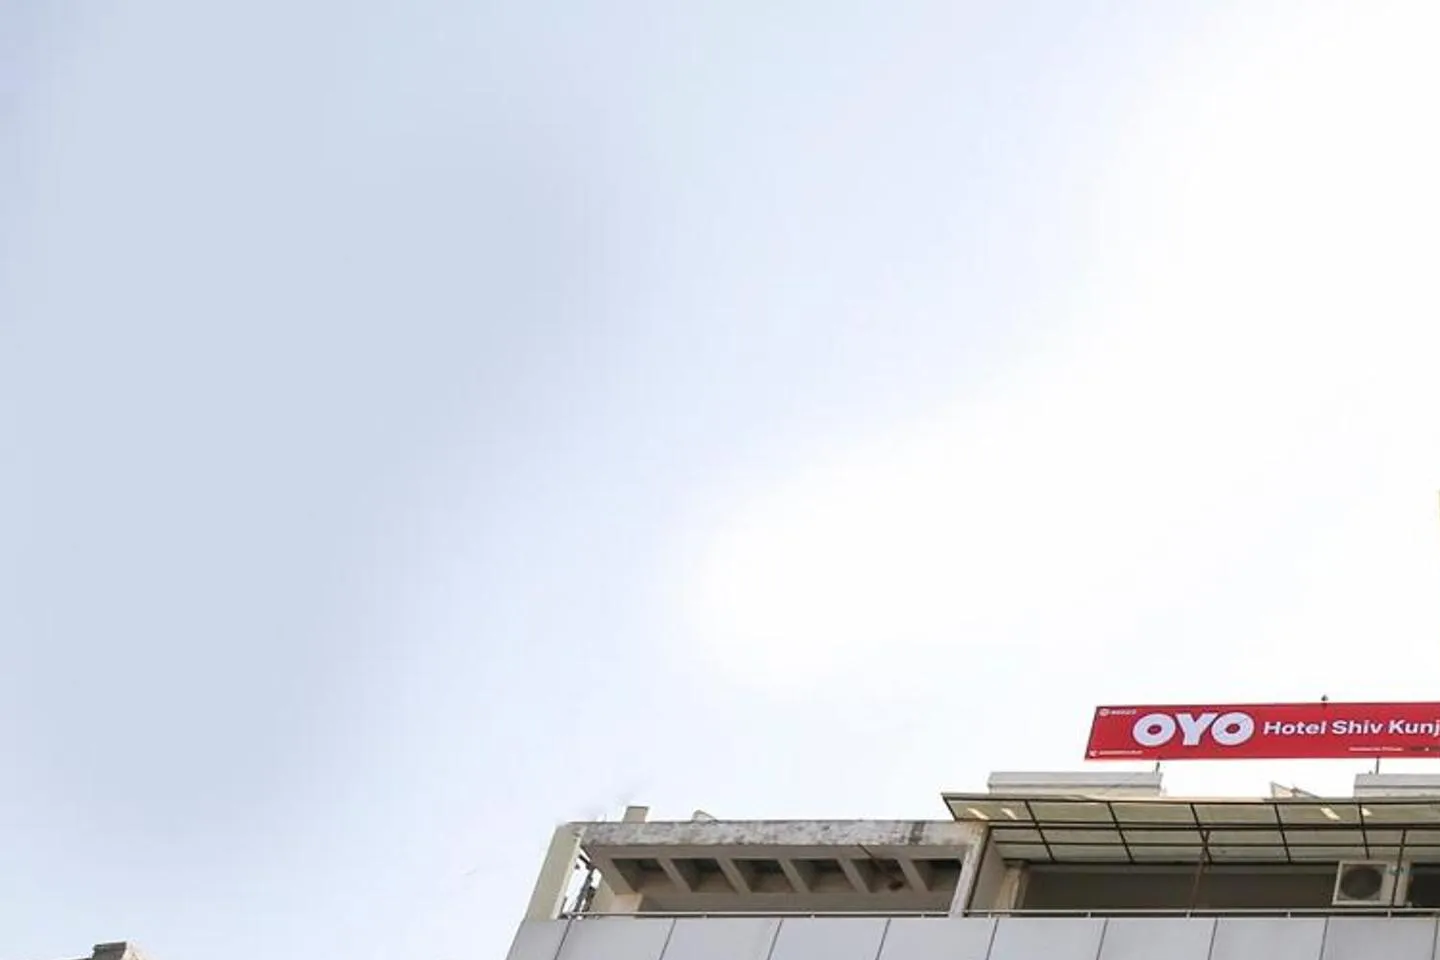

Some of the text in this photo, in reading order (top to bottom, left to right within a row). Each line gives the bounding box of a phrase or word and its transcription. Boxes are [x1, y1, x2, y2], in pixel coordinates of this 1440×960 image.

[1132, 712, 1254, 747] OYO
[1264, 720, 1327, 735] Hotel
[1332, 719, 1383, 735] Shiv
[1388, 719, 1440, 737] Kunj
